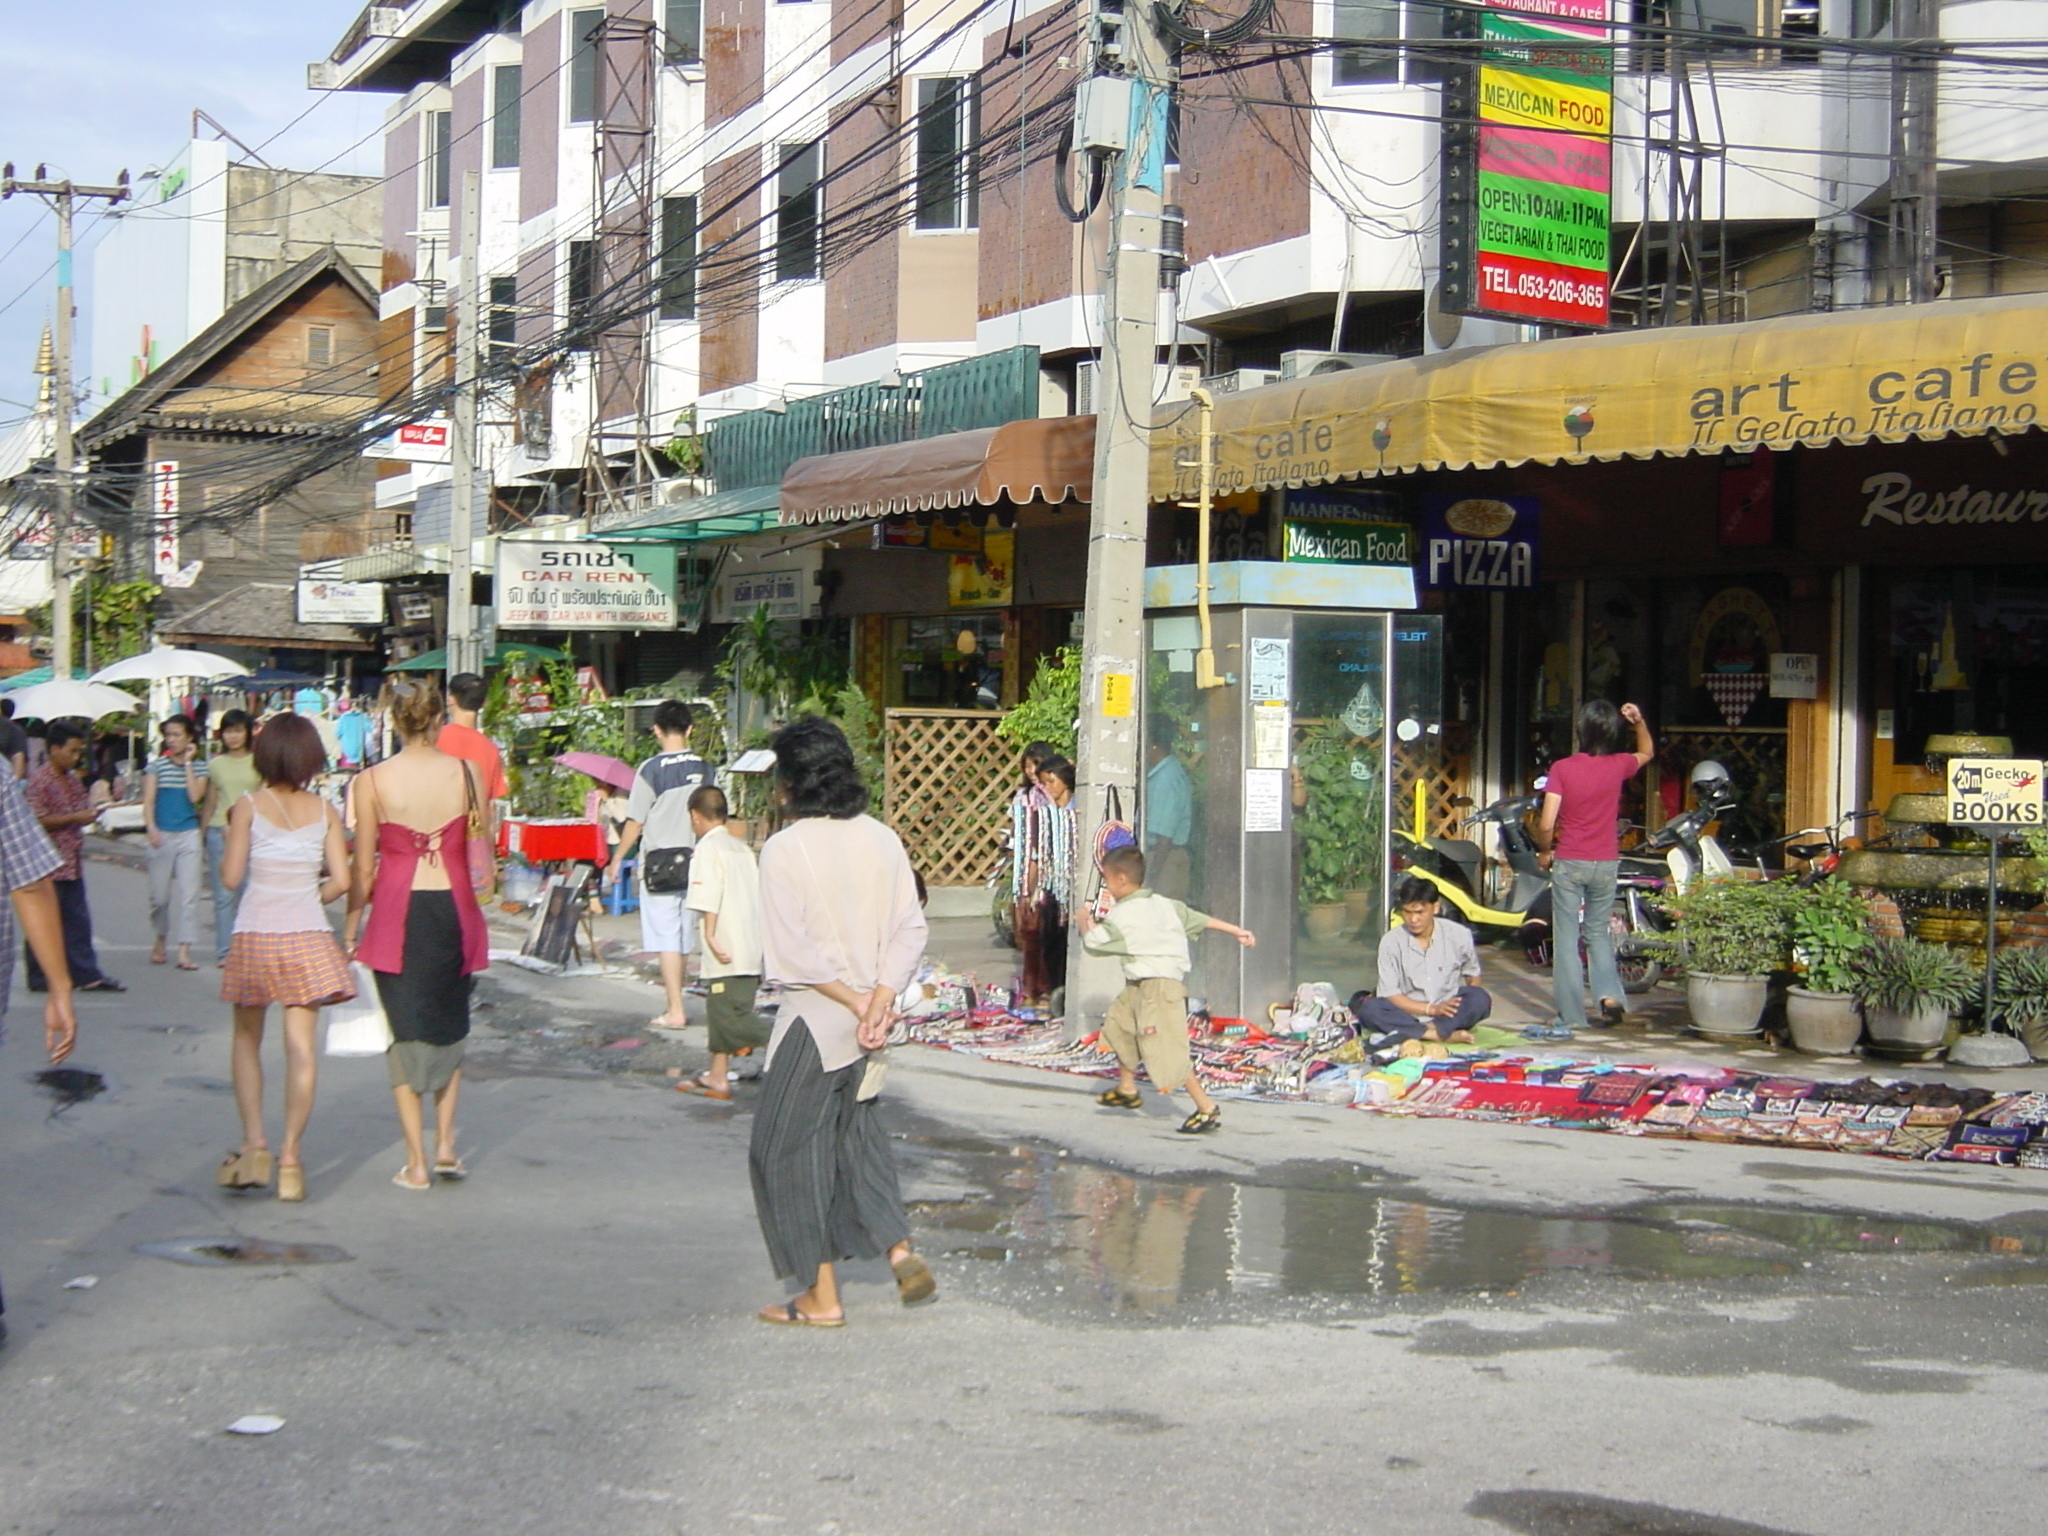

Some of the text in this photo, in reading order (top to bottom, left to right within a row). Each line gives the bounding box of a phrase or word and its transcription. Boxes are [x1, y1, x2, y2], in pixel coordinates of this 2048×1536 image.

[1491, 0, 1557, 15] STAURANT
[1559, 4, 1568, 16] &
[1484, 83, 1604, 127] MEXICAN FOOD
[1480, 220, 1605, 261] VEGETARIAN & THAI FOOD
[1690, 372, 1801, 420] art
[1735, 411, 1856, 443] Gelato
[1866, 401, 2038, 434] Italiano
[1173, 433, 1224, 471] art
[1191, 465, 1244, 489] Glato
[1252, 457, 1330, 484] Italiano
[541, 547, 634, 567] รถเช่า
[1288, 527, 1361, 561] Mexican
[1366, 533, 1407, 563] Food
[522, 571, 653, 583] CAR RENT
[1429, 538, 1532, 588] PIZZA
[1984, 766, 2030, 780] Gecko
[1952, 801, 2038, 822] BOOKS
[1982, 788, 2010, 804] Used
